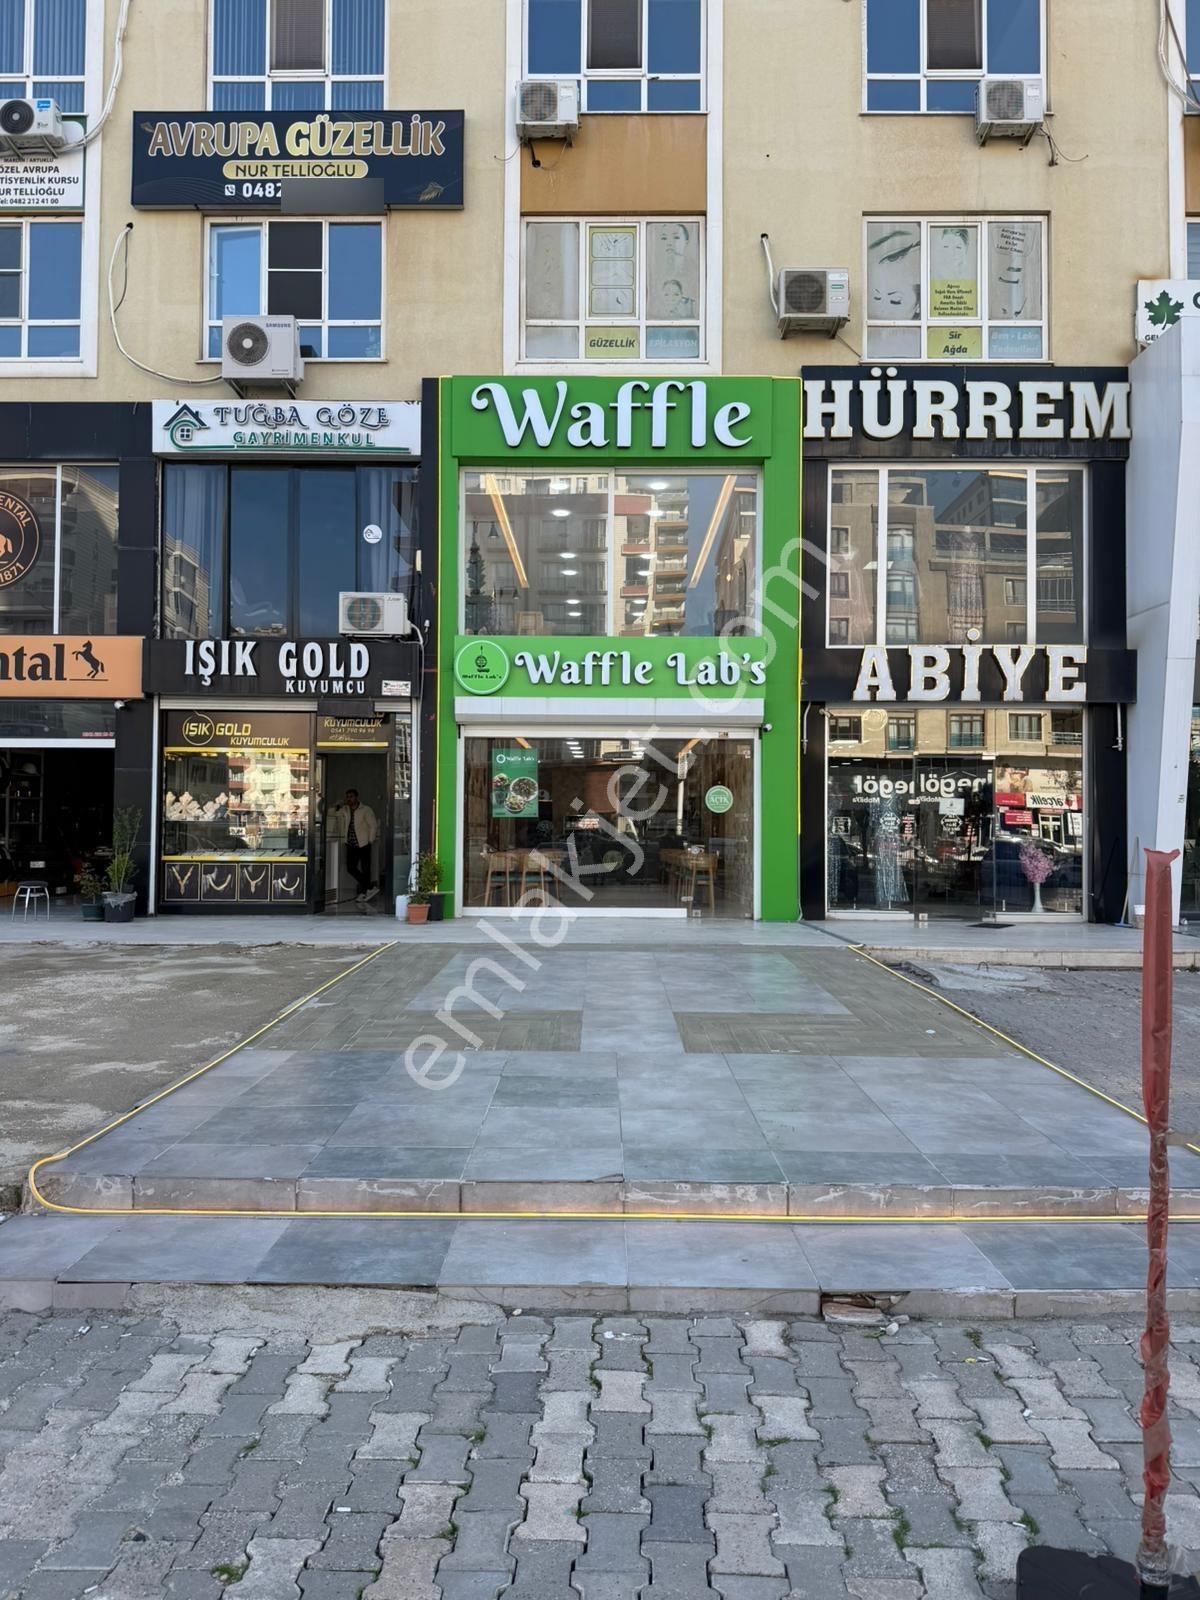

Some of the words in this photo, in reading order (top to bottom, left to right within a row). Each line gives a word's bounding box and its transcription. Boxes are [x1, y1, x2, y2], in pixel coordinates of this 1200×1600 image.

[149, 121, 280, 157] AVRUPA
[285, 113, 446, 156] GÜZELLİK
[22, 166, 60, 174] AVRUPA
[235, 164, 268, 177] NUR
[272, 161, 356, 178] TELLİOĞLU
[48, 177, 79, 185] KURSU
[14, 186, 65, 196] TELLİOĞLU
[589, 336, 637, 348] GÜZELLİK
[943, 344, 968, 355] Ağda
[803, 366, 1132, 439] HÜRREM
[213, 403, 306, 428] TUĞBA
[316, 403, 391, 428] GÖZE
[471, 380, 753, 448] Waffle
[233, 430, 375, 447] GAYRİMENKUL
[184, 641, 258, 685] IŞIK
[278, 642, 371, 678] GOLD
[514, 650, 654, 685] Waffle
[667, 651, 767, 685] Lab's
[852, 628, 1087, 702] ABİYE
[285, 679, 366, 694] KUYUMCU
[216, 723, 252, 736] GOLD
[324, 718, 382, 728] KUYUMCULUK
[230, 737, 290, 746] KUYUMCULUK
